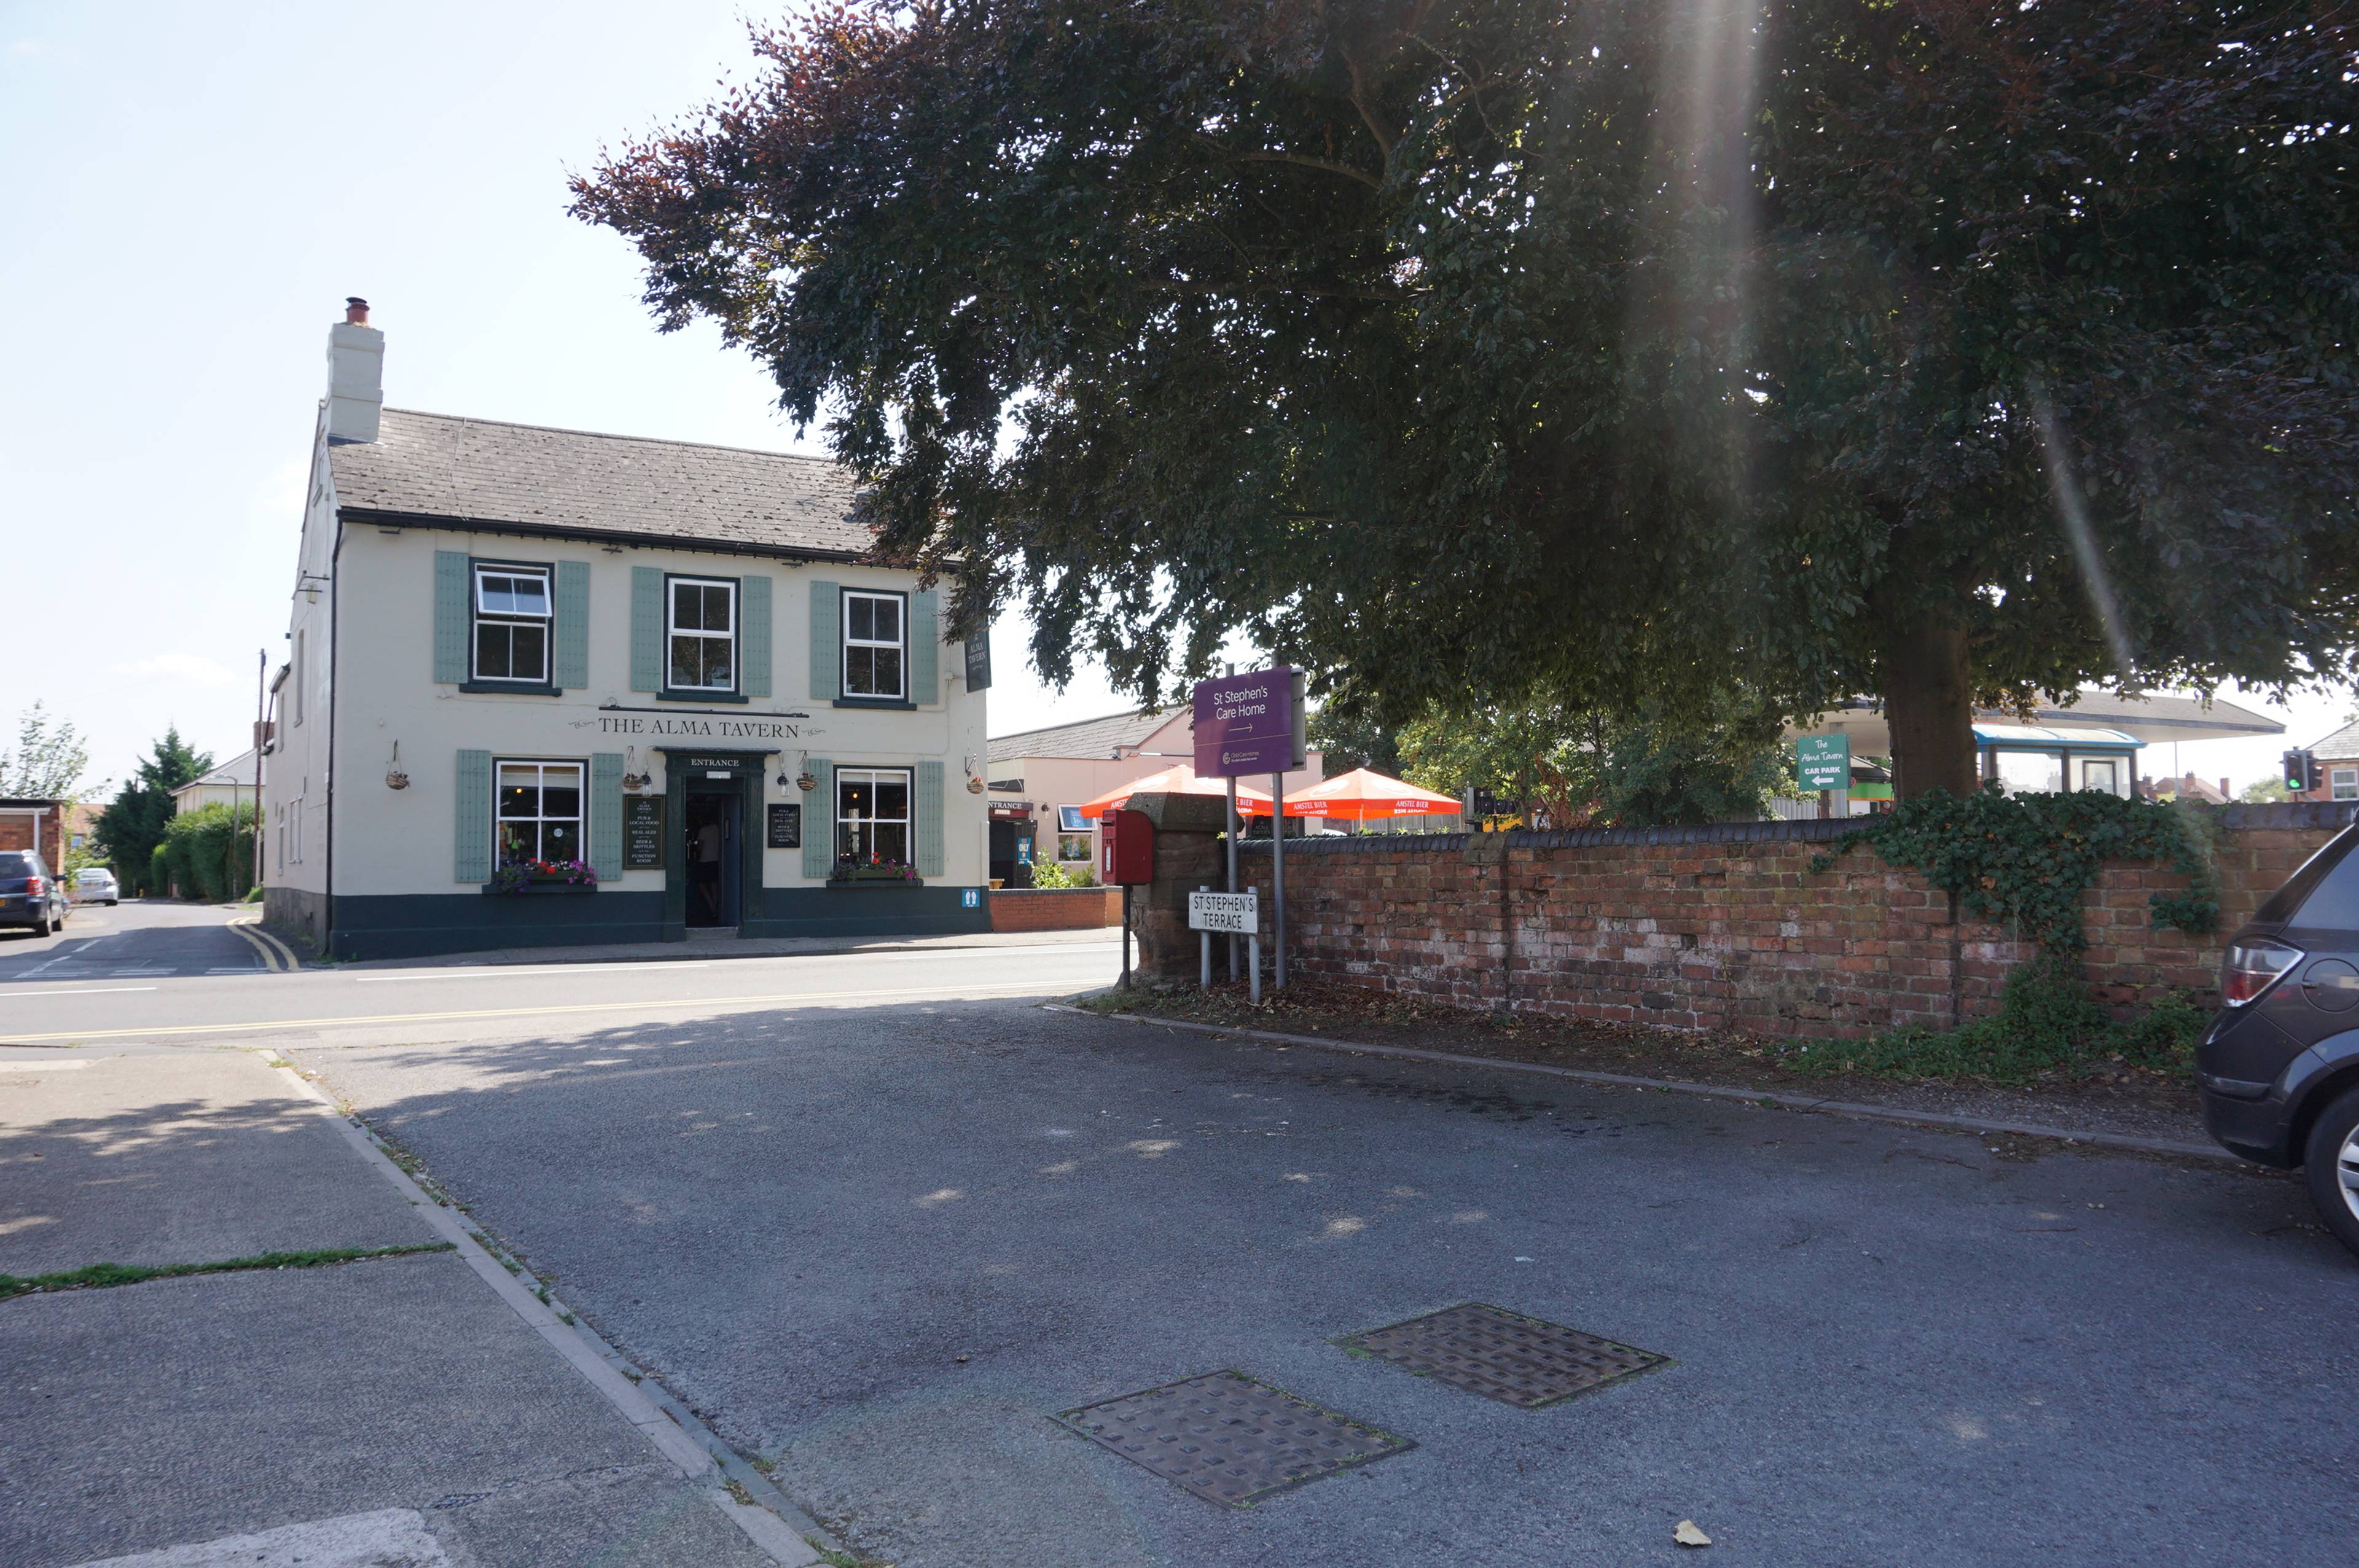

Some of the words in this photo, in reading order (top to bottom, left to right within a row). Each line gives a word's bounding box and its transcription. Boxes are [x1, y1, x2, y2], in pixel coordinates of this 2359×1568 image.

[970, 642, 983, 653] ALMA
[968, 652, 985, 663] TAVERN
[1214, 693, 1223, 705] St
[1225, 685, 1268, 703] Stephen's
[1216, 708, 1236, 720] Care
[1238, 704, 1266, 717] Home
[599, 718, 644, 733] THE
[651, 720, 712, 736] ALMA
[719, 722, 799, 738] TAVERN
[1815, 739, 1828, 749] The
[1802, 753, 1820, 762] Alma
[1821, 751, 1844, 760] Tavern
[691, 759, 740, 767] ENTRANCE
[1111, 798, 1128, 809] AMST
[1194, 896, 1203, 909] ST
[1207, 896, 1253, 912] STEPHEN'S
[1203, 913, 1242, 929] TERRACE
